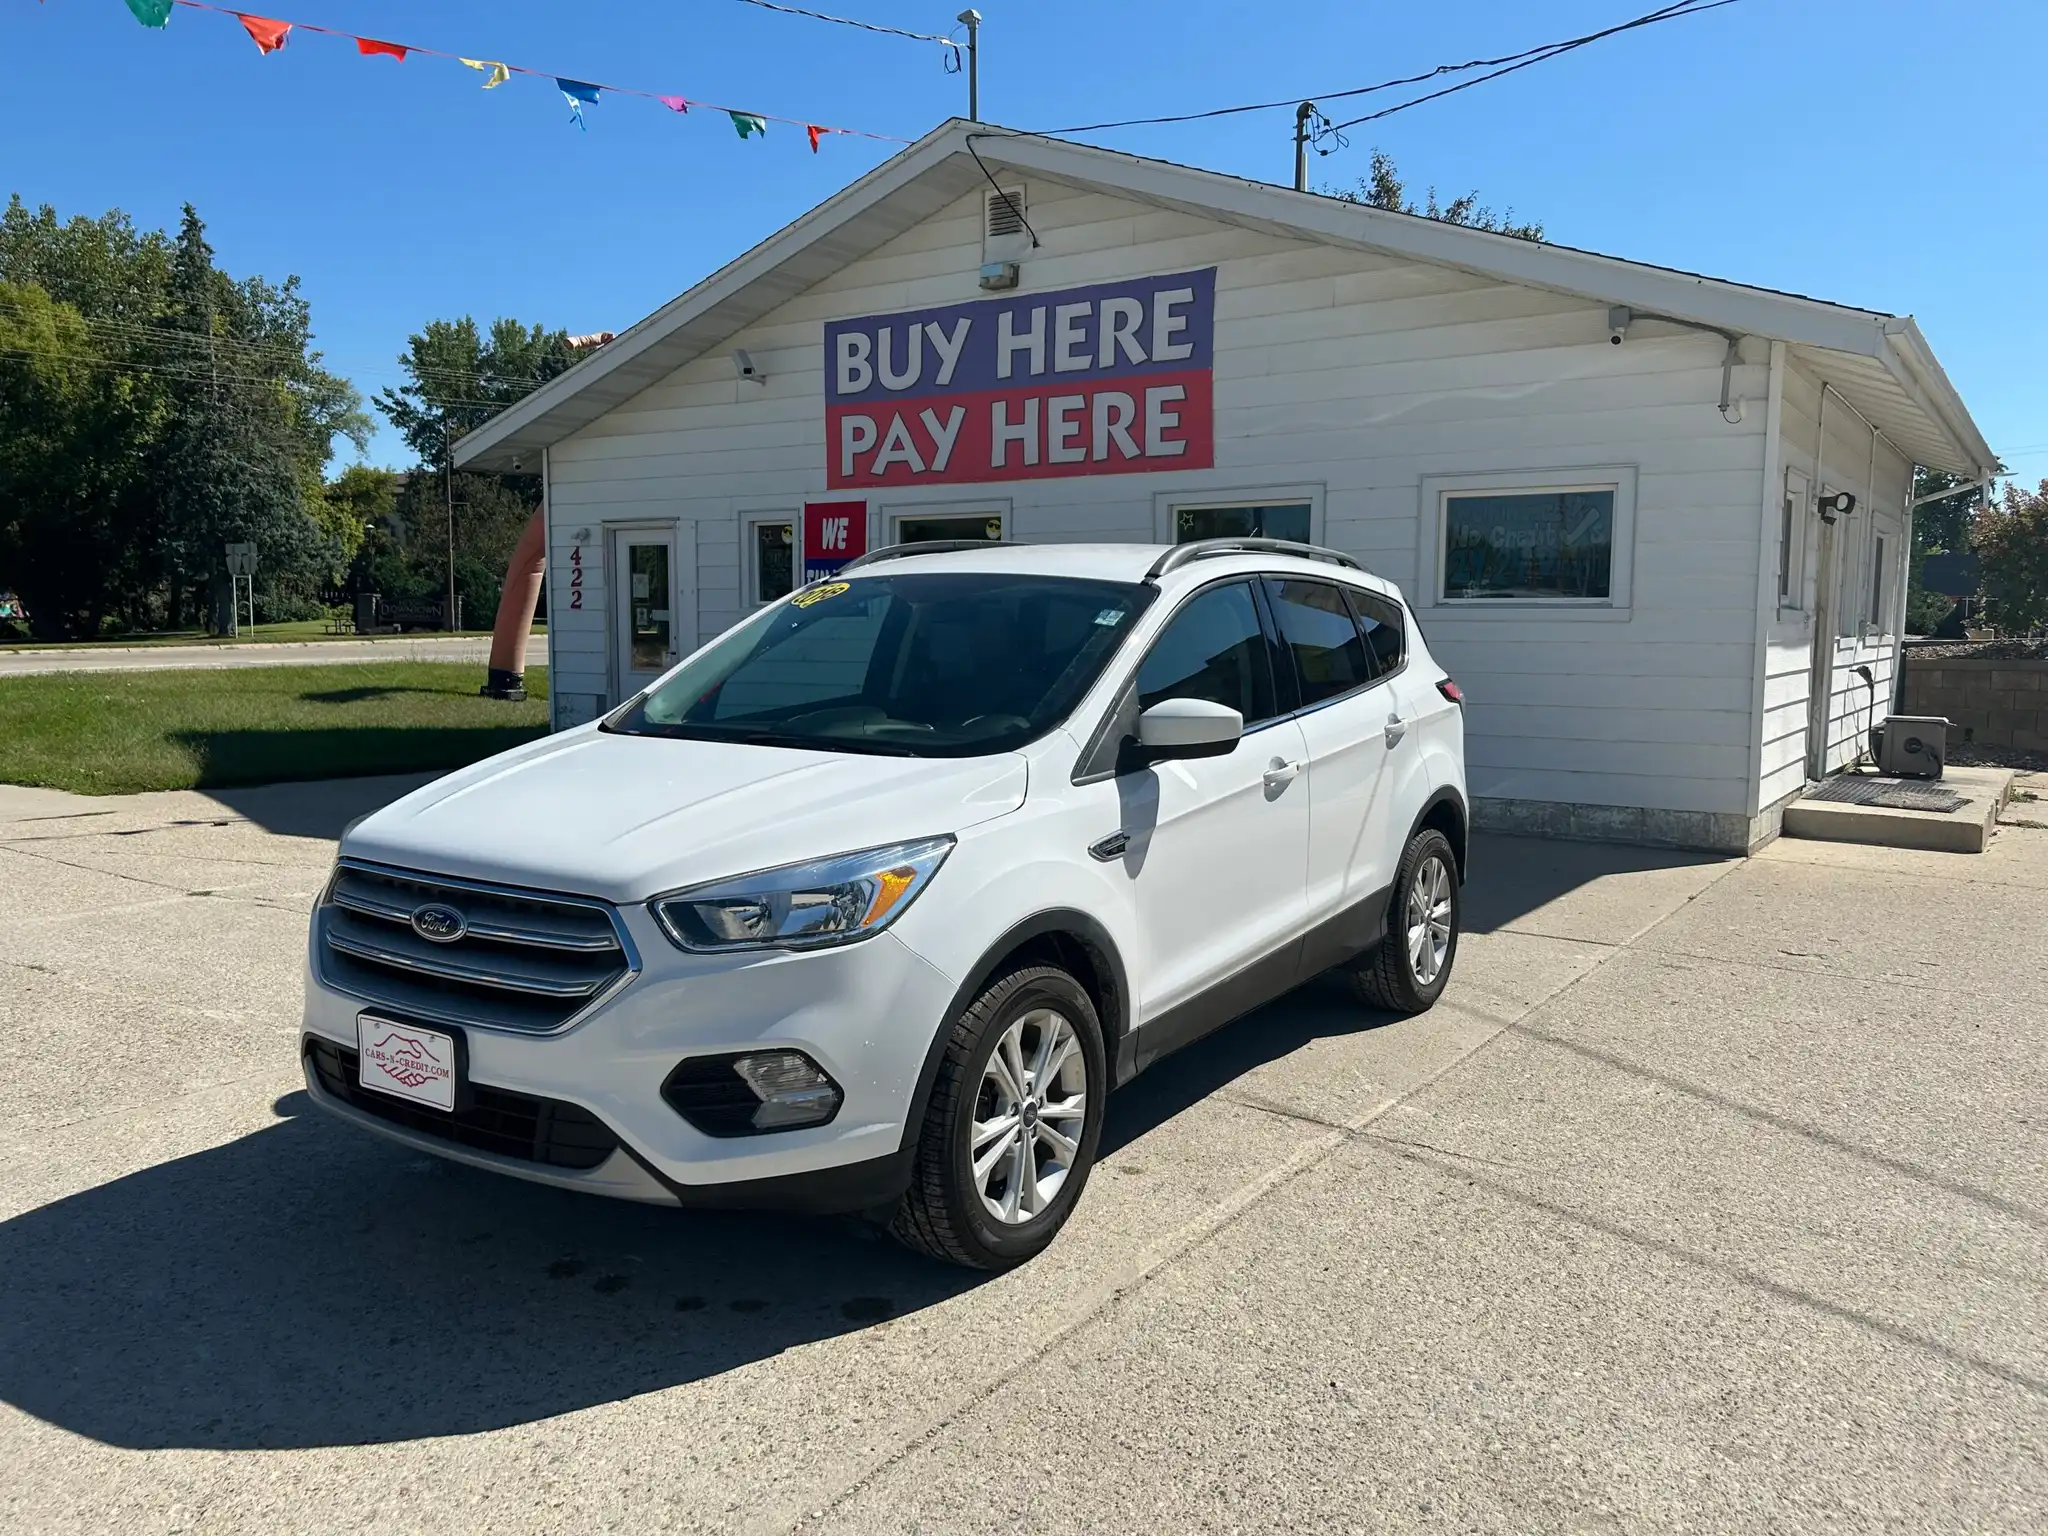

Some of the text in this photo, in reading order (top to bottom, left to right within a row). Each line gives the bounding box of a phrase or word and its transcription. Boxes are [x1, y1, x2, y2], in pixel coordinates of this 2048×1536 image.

[836, 287, 1195, 395] BUY HERE
[840, 384, 1188, 478] PAY HERE
[822, 517, 850, 550] WE
[1489, 521, 1556, 548] Credit
[570, 545, 583, 609] 422
[421, 911, 450, 932] Ford
[365, 1048, 450, 1078] CARS-N-CREDIT.COM
